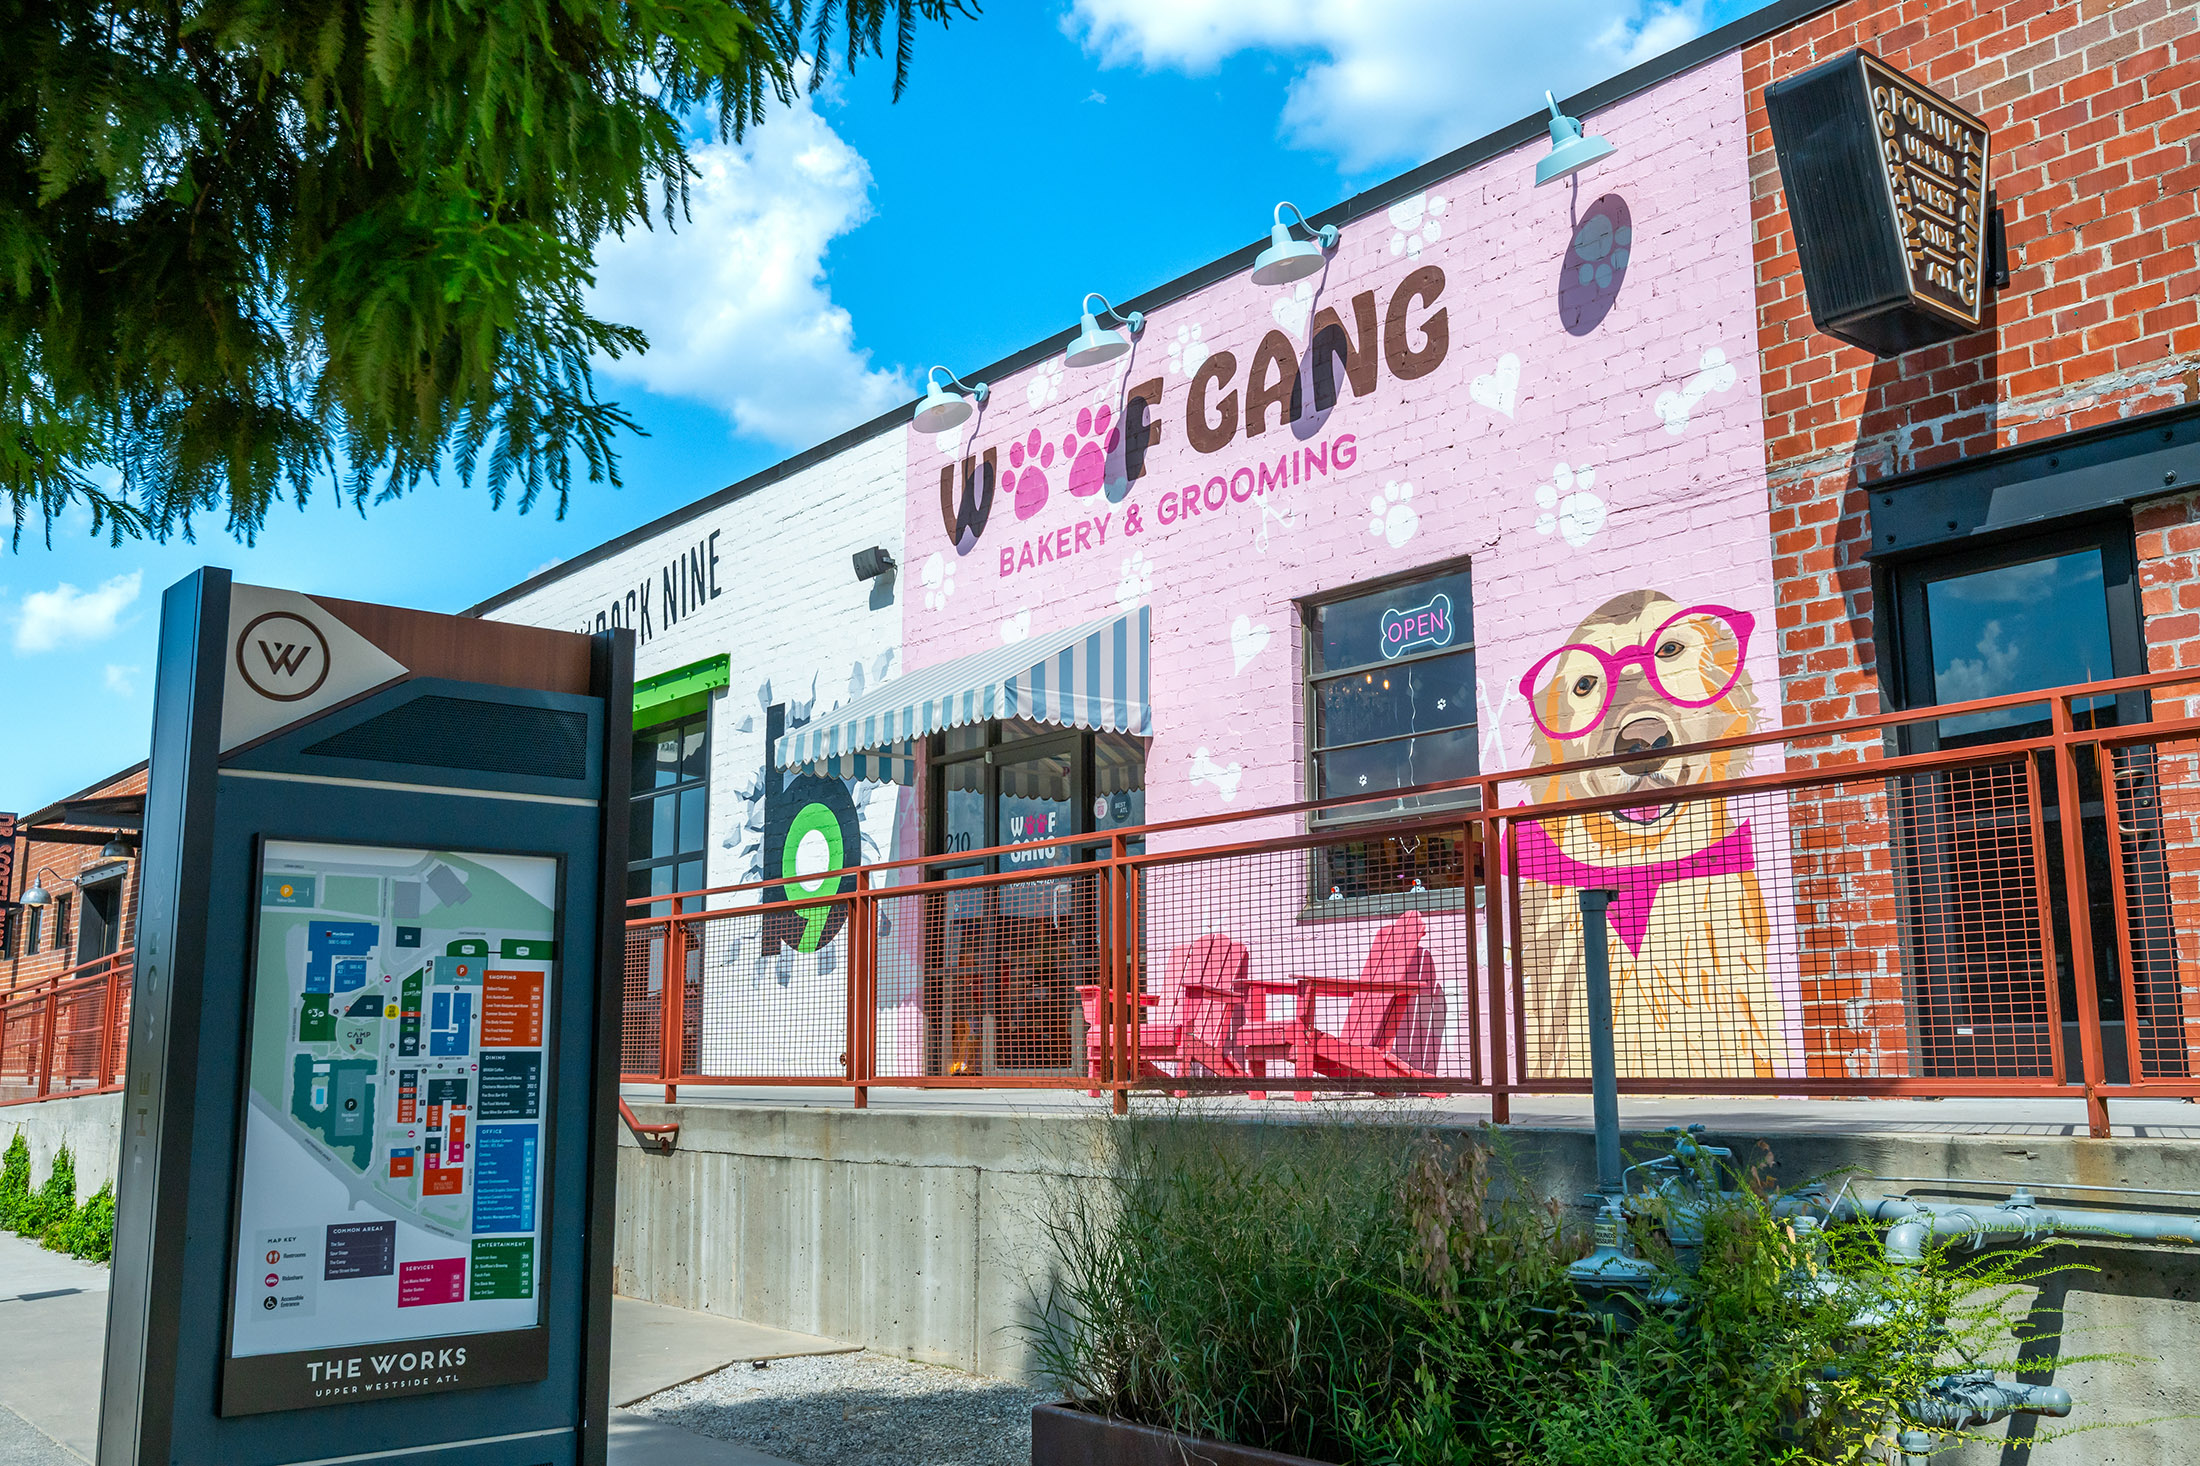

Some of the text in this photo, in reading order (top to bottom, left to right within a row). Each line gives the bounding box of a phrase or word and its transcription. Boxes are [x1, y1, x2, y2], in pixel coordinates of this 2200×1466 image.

[1890, 87, 1963, 150] FORUM
[1903, 133, 1955, 178] UPPER
[1873, 85, 1925, 271] COCKTAIL
[1911, 175, 1956, 214] WEST
[1919, 220, 1957, 254] SIDE
[1958, 130, 1983, 306] COMPANY
[1926, 262, 1957, 292] ATL
[940, 265, 1450, 547] WF GANG
[999, 434, 1358, 578] BAKERY & GROOMING
[663, 528, 722, 632] NINE
[1387, 607, 1445, 644] OPEN
[946, 831, 971, 854] 210
[1010, 812, 1056, 837] WF
[306, 1347, 467, 1382] THE WORKS
[315, 1374, 459, 1397] UPPER WESTSIDE ATL
